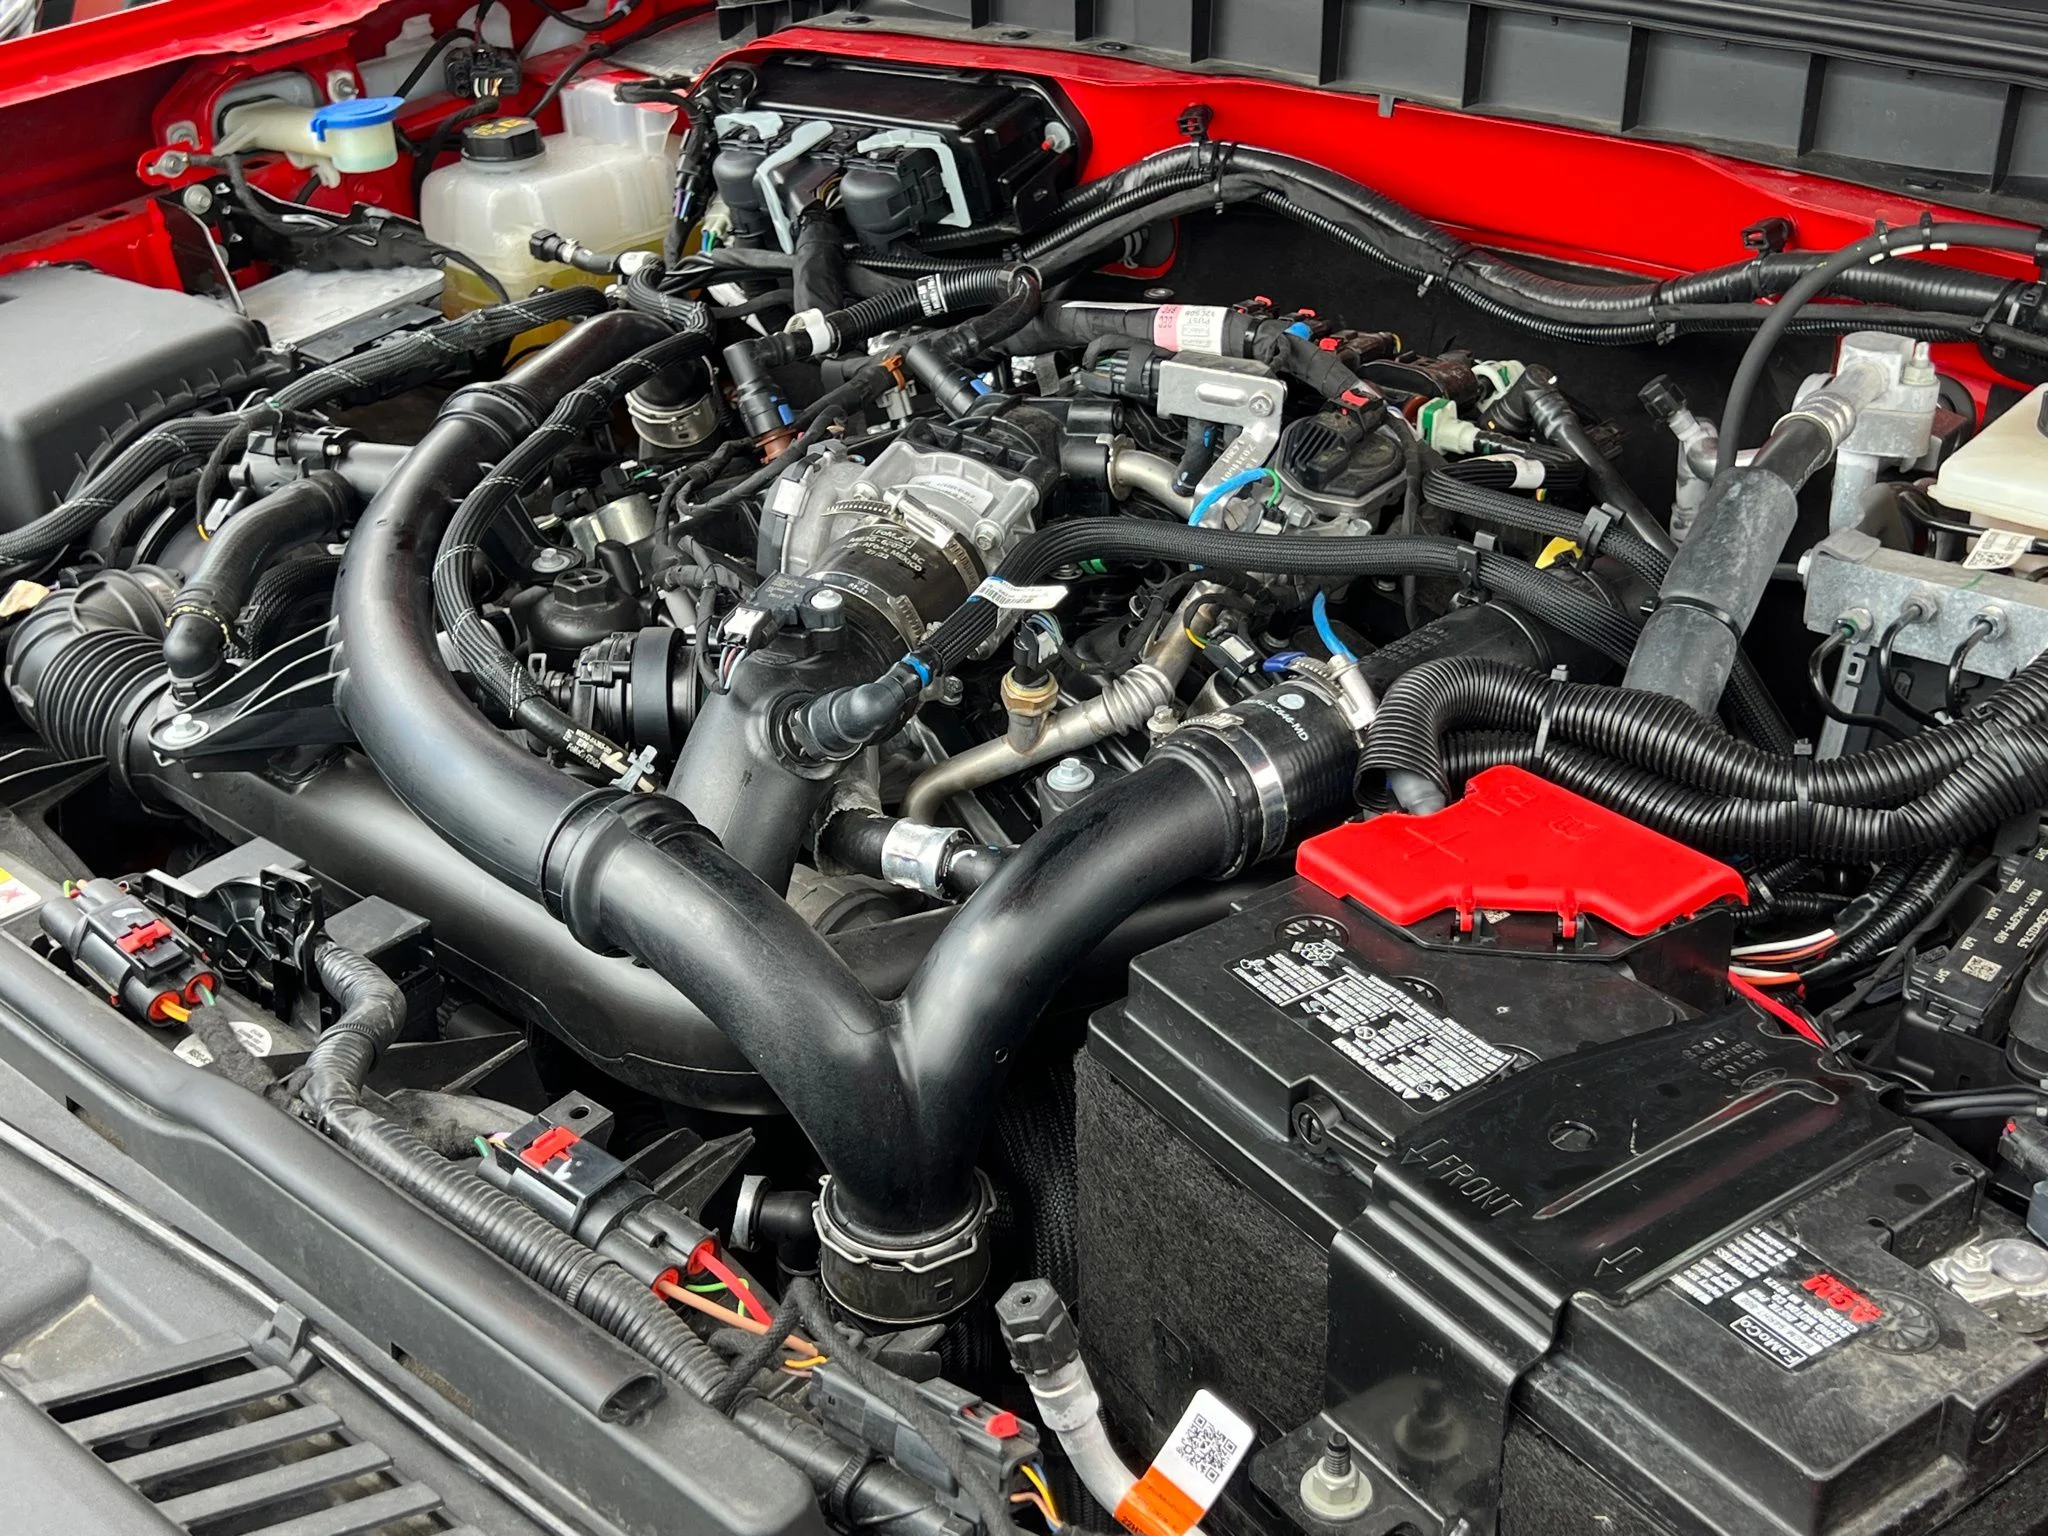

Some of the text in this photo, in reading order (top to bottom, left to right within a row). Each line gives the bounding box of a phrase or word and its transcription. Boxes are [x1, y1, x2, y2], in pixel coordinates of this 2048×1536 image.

[1427, 1154, 1523, 1217] FRONT
[1800, 1273, 1877, 1328] AGM
[1737, 1318, 1801, 1364] FoMoCo
